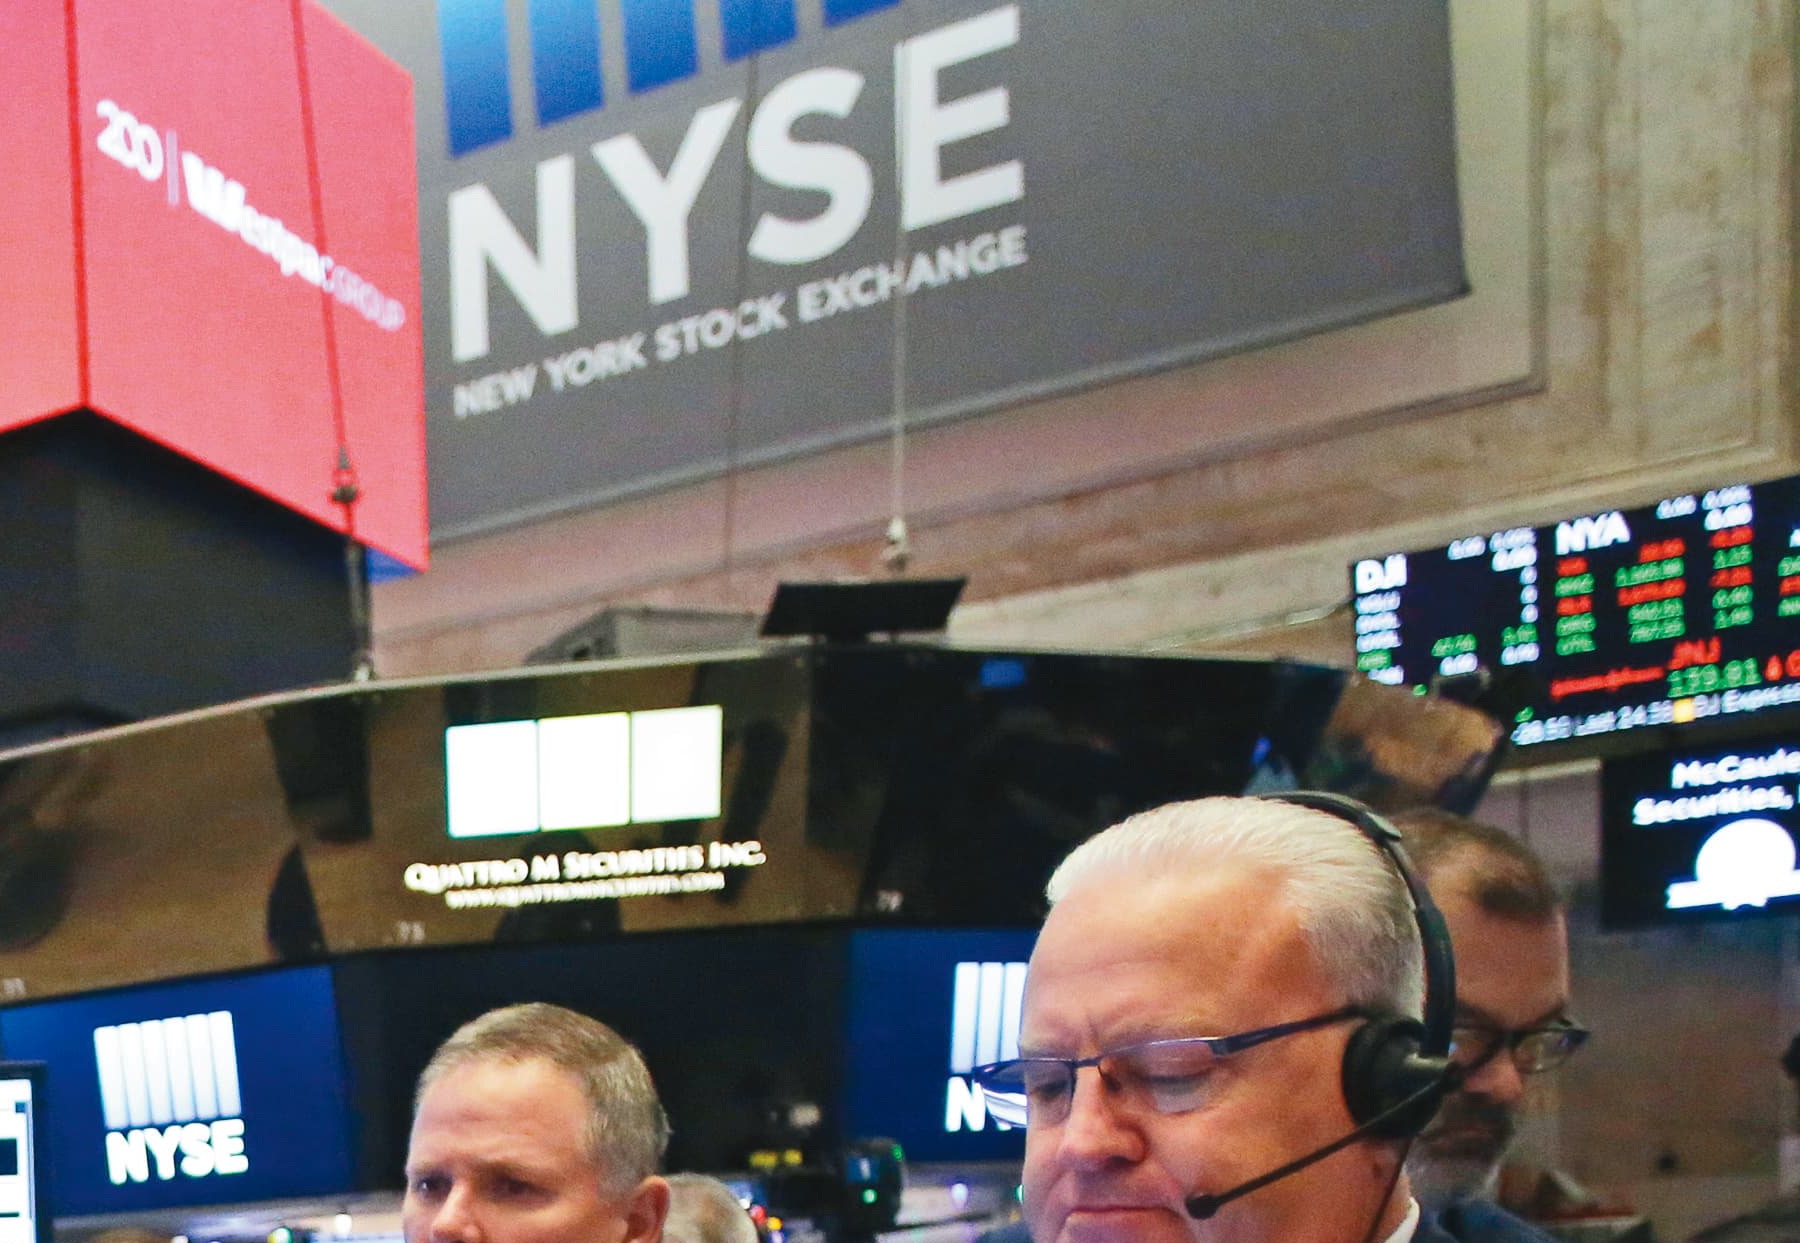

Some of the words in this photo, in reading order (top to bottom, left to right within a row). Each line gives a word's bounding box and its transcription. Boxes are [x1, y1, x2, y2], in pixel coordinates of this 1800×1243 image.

[96, 99, 164, 181] 200
[448, 5, 1025, 362] NYSE
[453, 363, 538, 420] NEW
[543, 334, 648, 393] YORK
[654, 292, 789, 362] STOCK
[797, 224, 1029, 323] EXCHANGE
[404, 859, 529, 894] QUATTRO
[531, 854, 560, 883] M
[105, 1119, 249, 1185] NYSE
